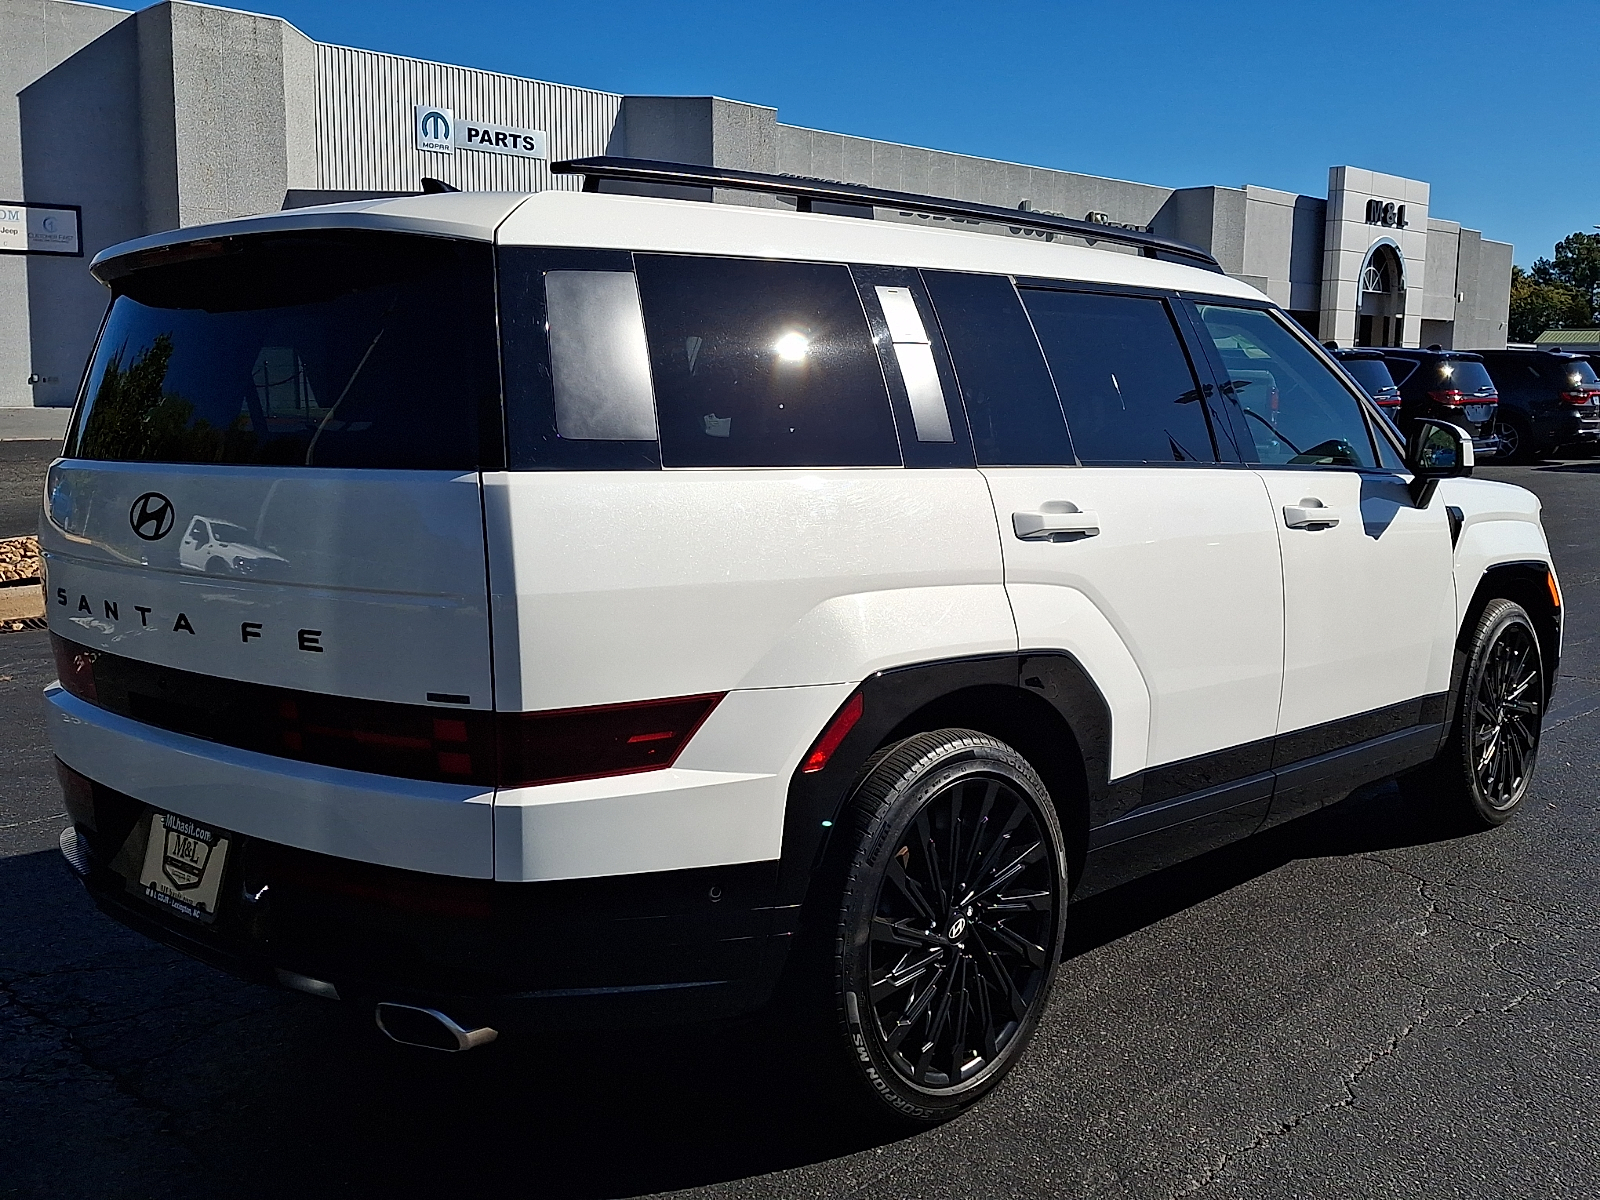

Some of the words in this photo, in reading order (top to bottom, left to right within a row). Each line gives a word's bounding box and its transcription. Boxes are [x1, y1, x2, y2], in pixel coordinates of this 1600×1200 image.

[422, 142, 450, 151] MOPAR
[466, 126, 535, 151] PARTS
[1364, 198, 1409, 230] M&L
[0, 226, 19, 236] Jeep
[56, 587, 196, 635] SANTA
[240, 621, 324, 653] FE
[172, 834, 200, 865] M&L
[866, 1066, 934, 1118] SCORPION
